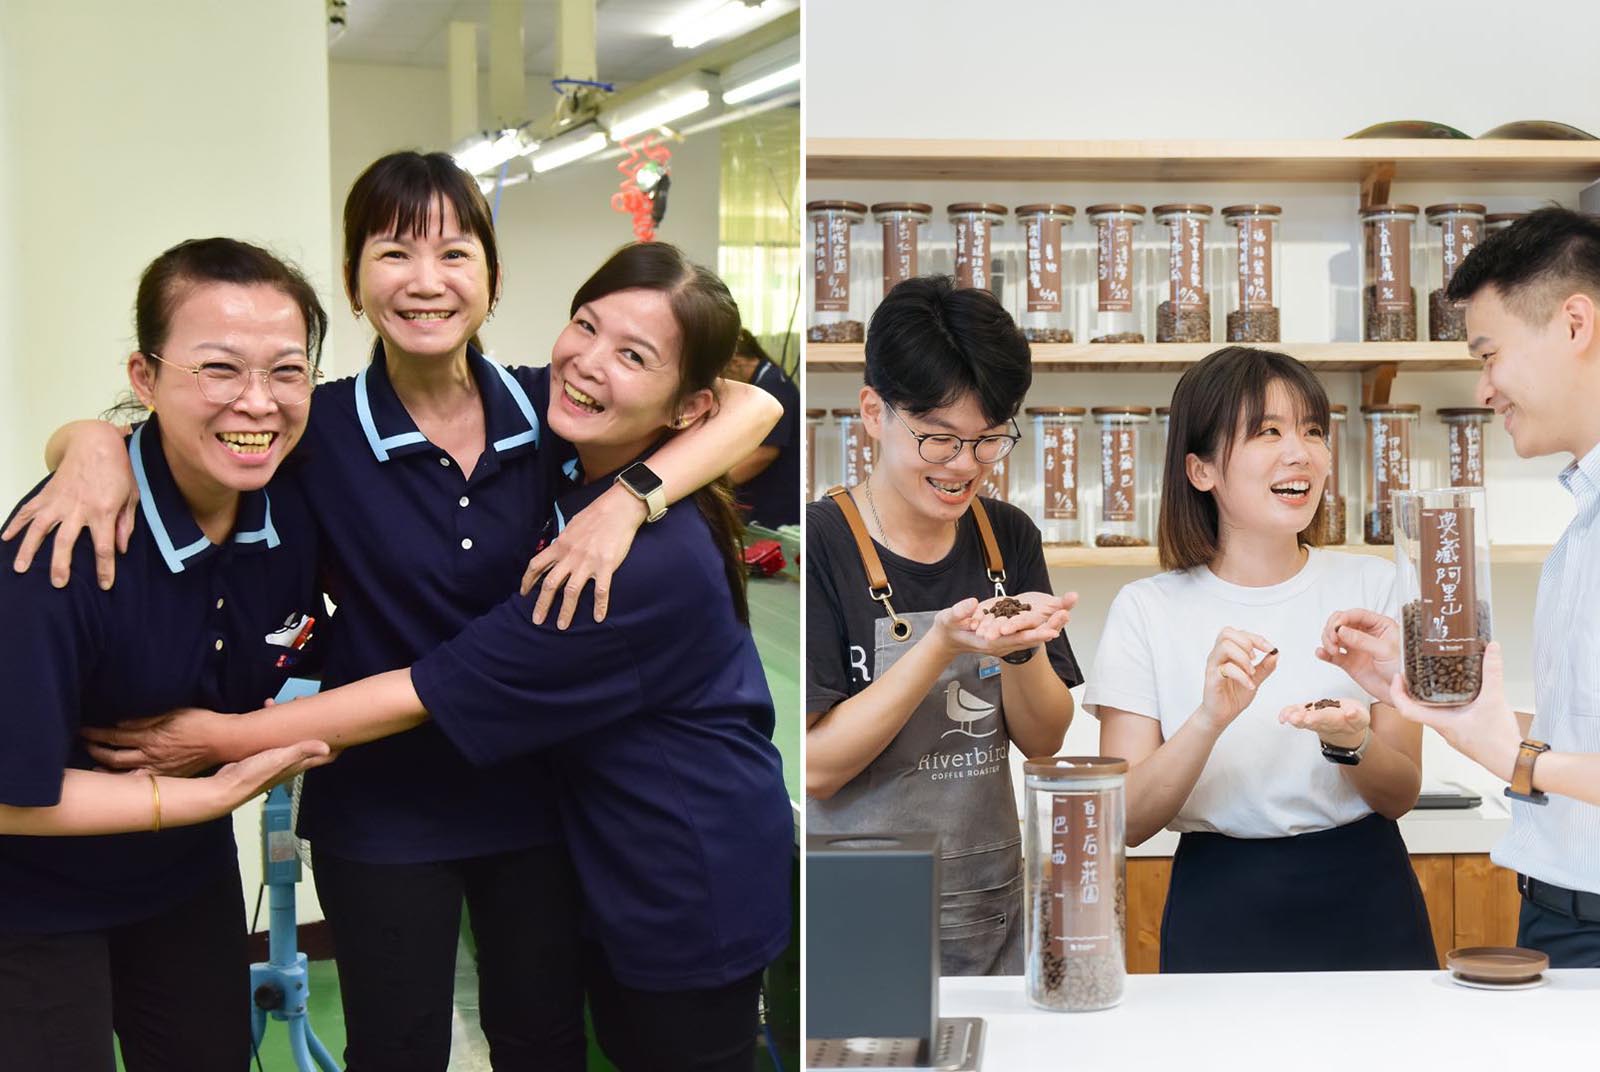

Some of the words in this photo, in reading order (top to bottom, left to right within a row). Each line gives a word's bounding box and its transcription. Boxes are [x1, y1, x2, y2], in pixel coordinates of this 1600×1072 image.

[1433, 615, 1449, 638] 7/3
[918, 742, 1009, 771] Riverbird
[931, 767, 964, 781] COFFEE
[967, 765, 1001, 779] ROASTER
[1052, 815, 1069, 865] 巴西
